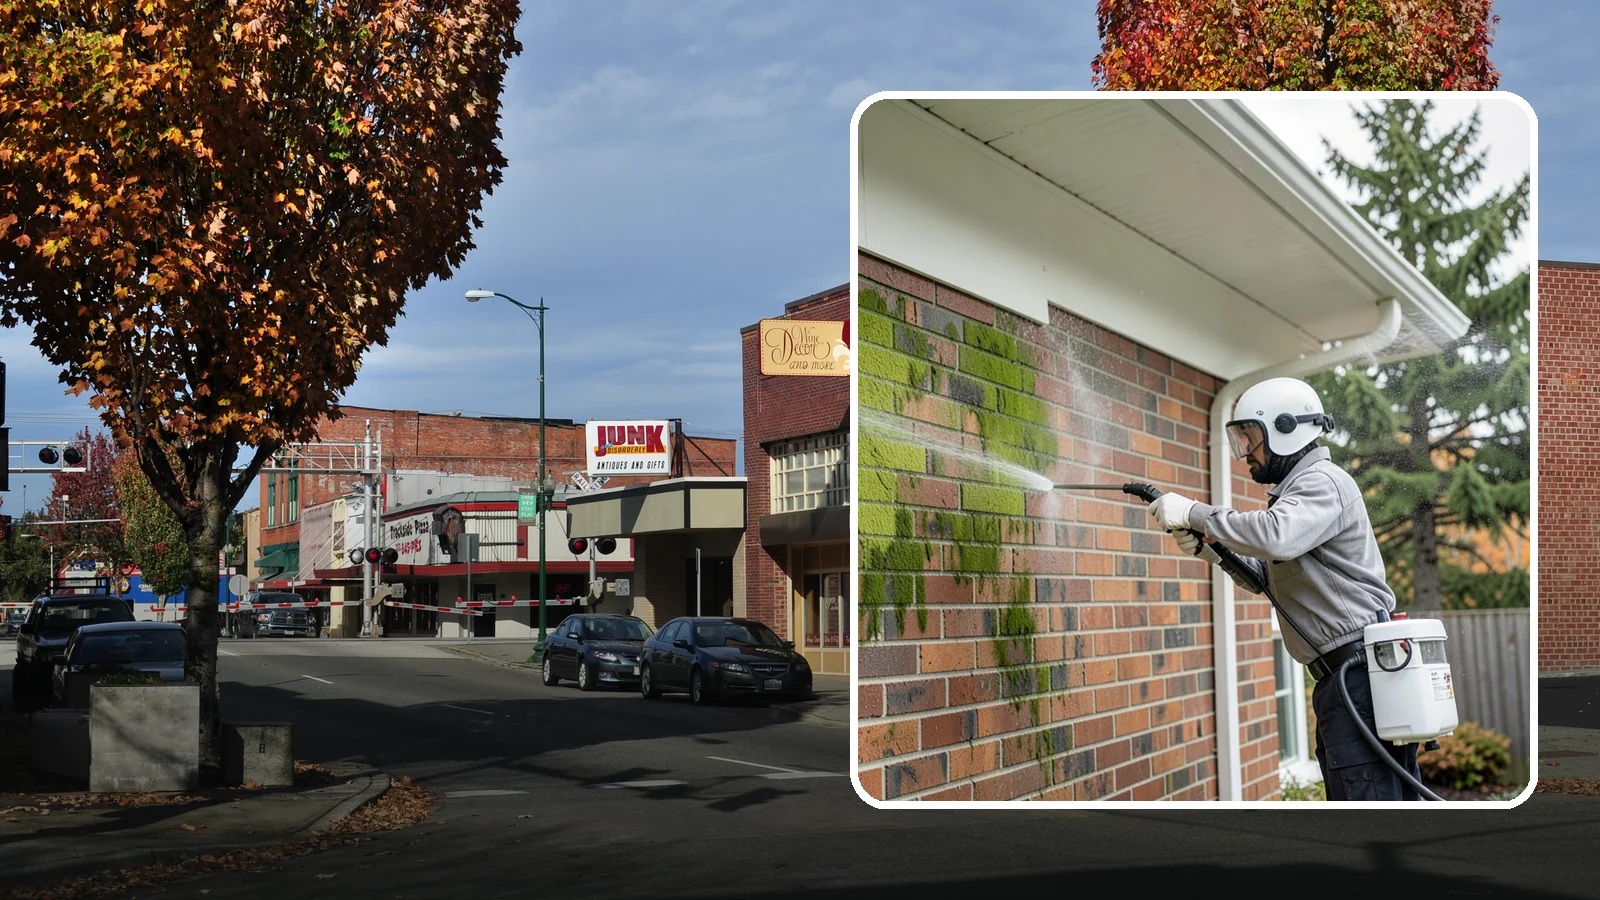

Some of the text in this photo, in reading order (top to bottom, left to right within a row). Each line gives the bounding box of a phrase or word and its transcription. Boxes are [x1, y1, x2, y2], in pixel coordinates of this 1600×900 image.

[595, 425, 665, 457] JUNK
[607, 446, 646, 454] DISORDERLY
[597, 460, 665, 470] ANTIQUES AND GIFTS
[390, 519, 429, 540] Trackside Pizza
